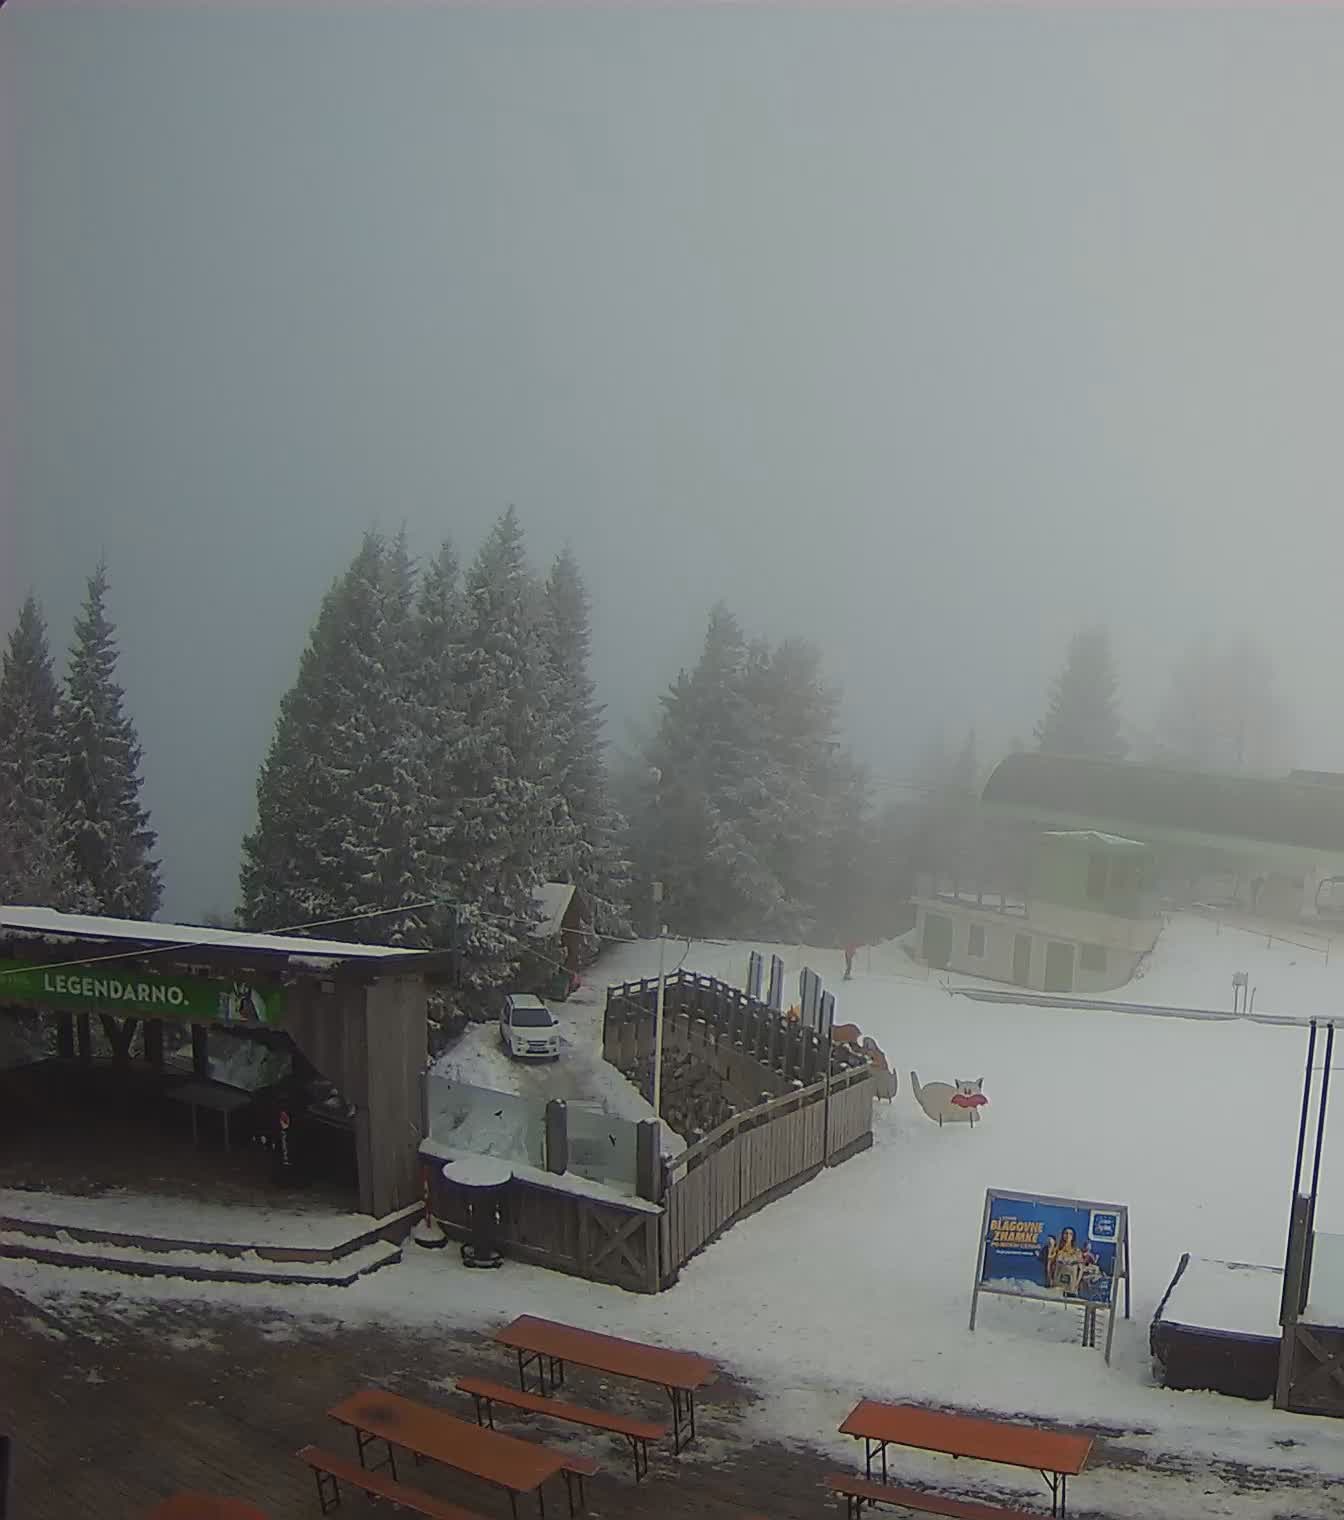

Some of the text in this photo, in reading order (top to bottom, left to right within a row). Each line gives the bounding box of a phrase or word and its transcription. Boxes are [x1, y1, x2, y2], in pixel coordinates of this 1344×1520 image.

[44, 972, 190, 1006] LEGENDARNO.
[991, 1219, 1044, 1233] BLAGOVNE
[993, 1231, 1040, 1243] ZNAMKE
